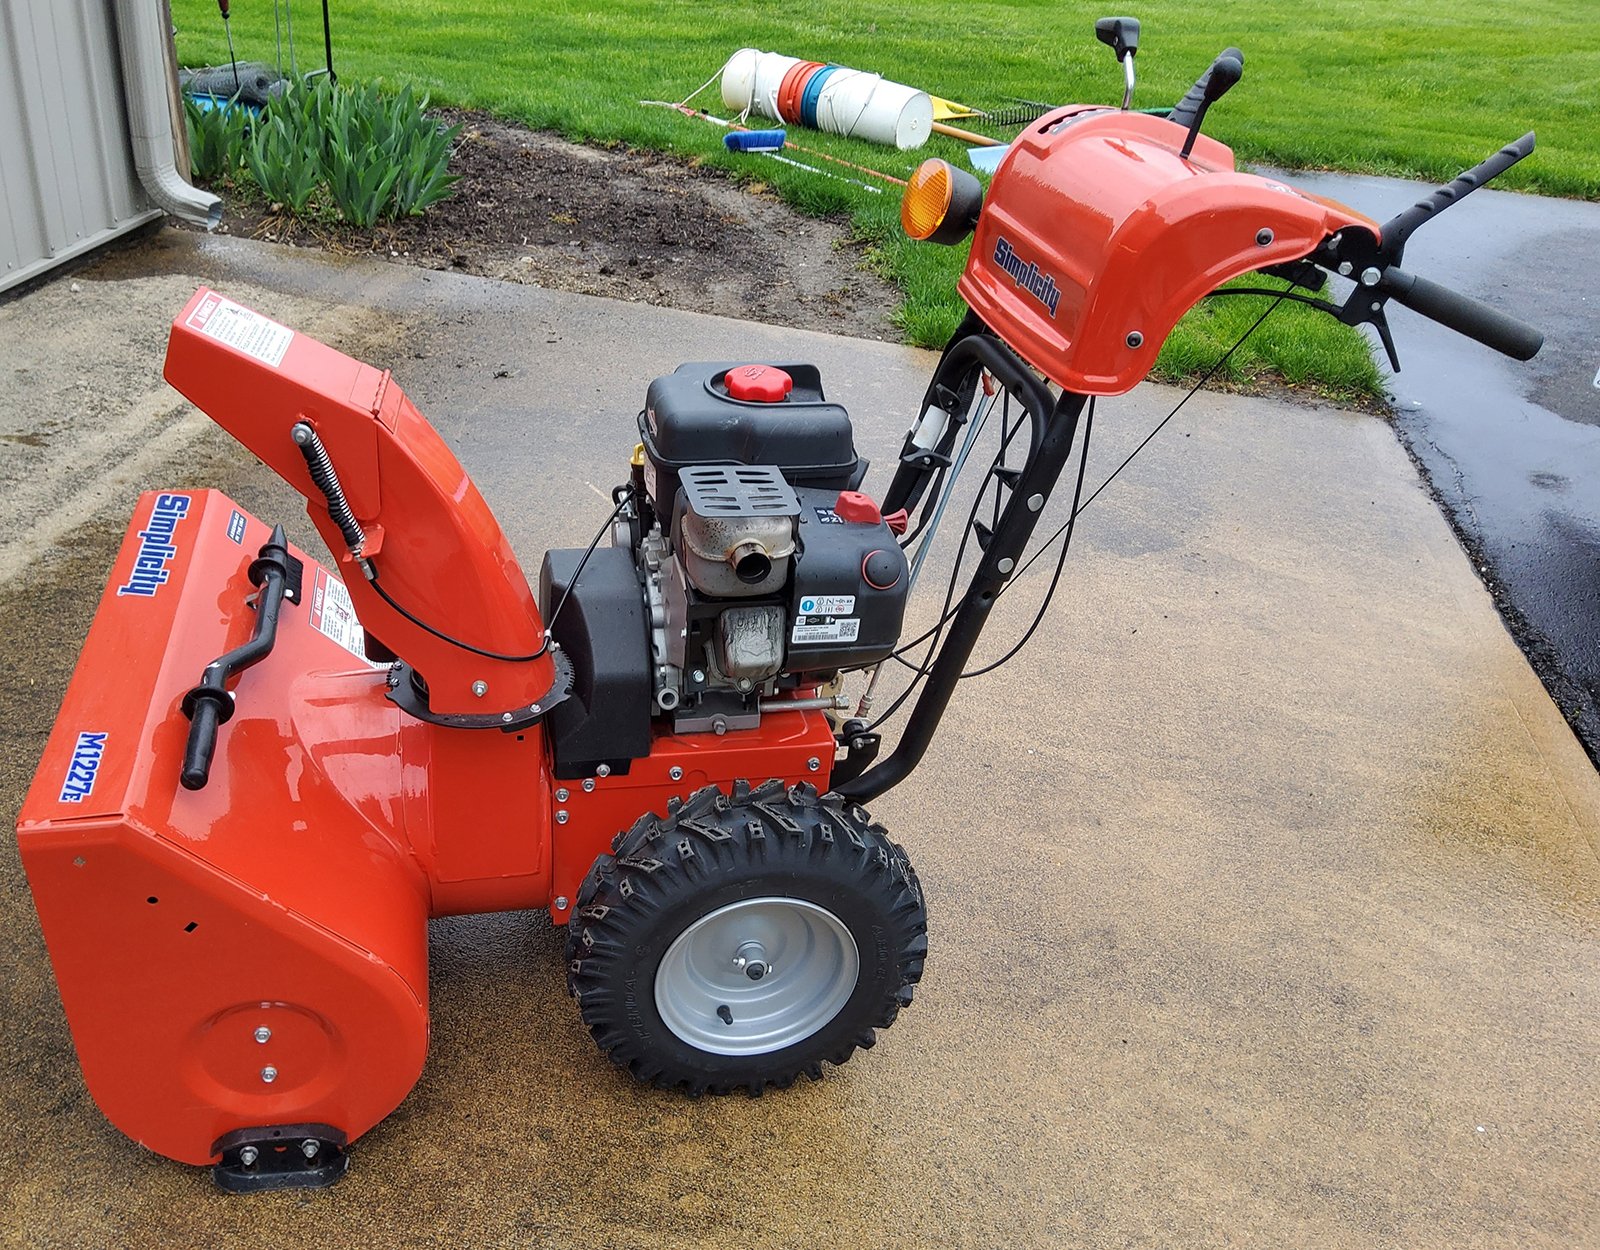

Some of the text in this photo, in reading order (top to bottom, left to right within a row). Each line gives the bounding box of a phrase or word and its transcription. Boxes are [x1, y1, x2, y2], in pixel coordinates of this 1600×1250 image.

[993, 236, 1061, 319] Simplicity
[118, 494, 191, 596] Simplicity
[59, 732, 108, 803] M1227E
